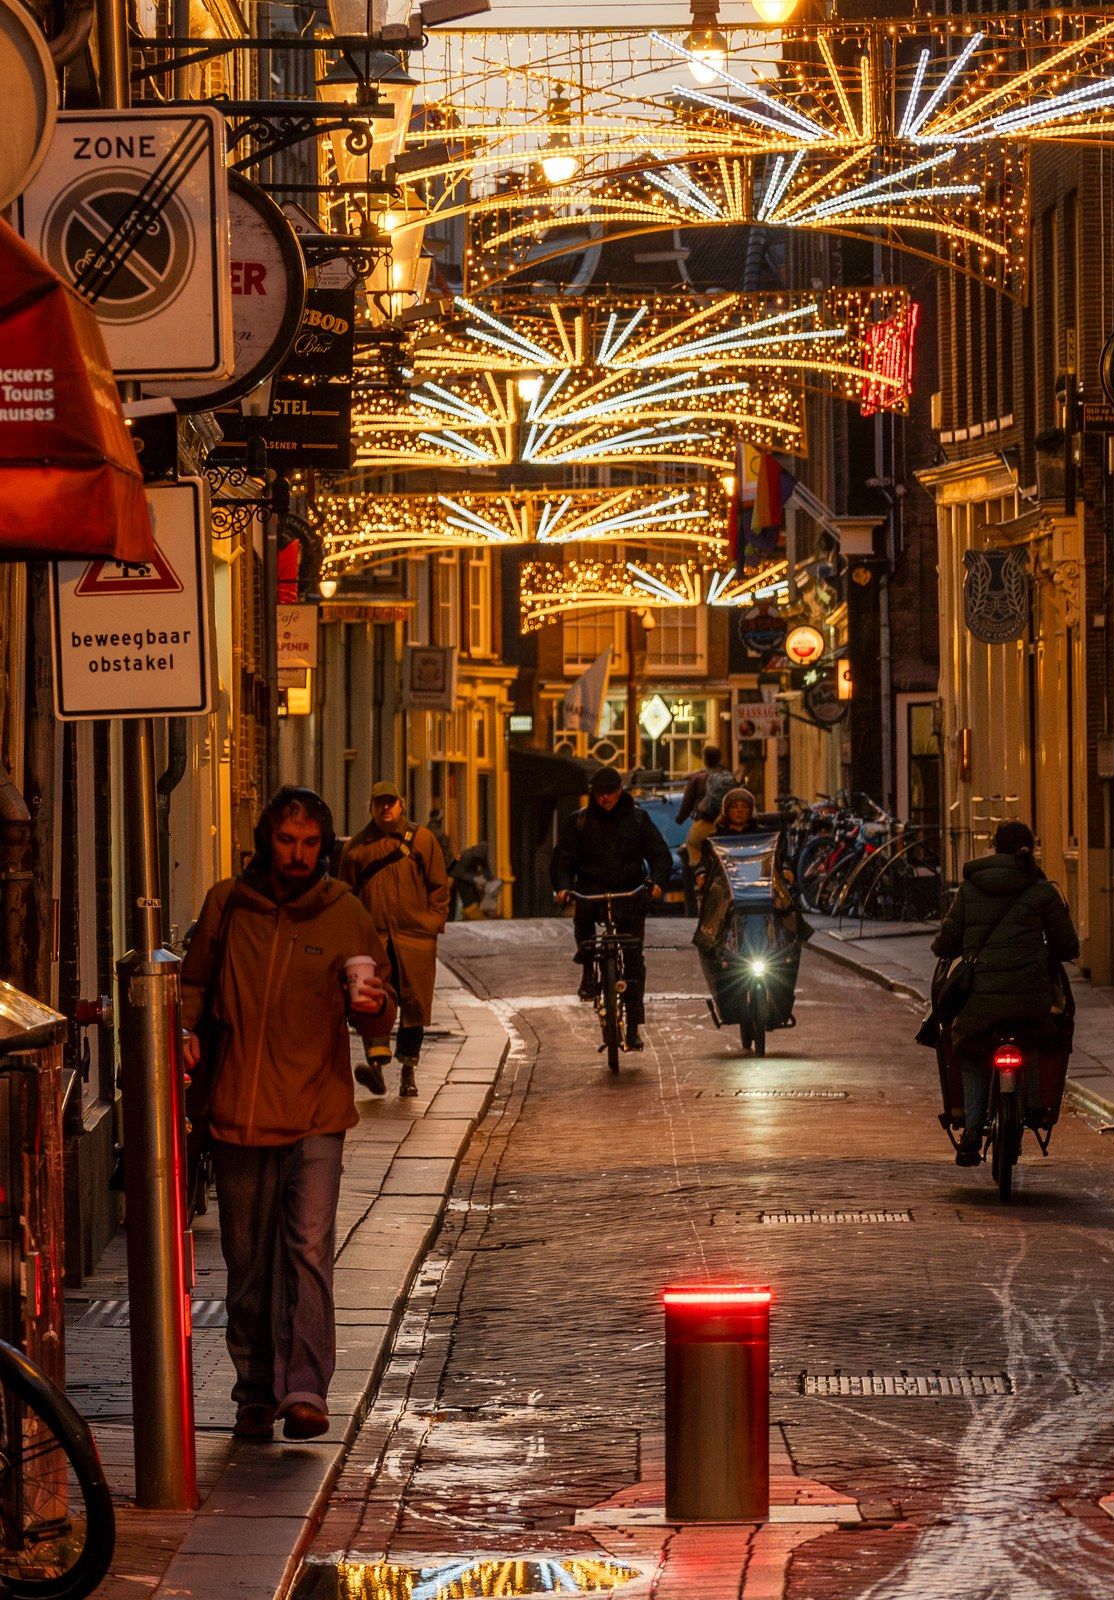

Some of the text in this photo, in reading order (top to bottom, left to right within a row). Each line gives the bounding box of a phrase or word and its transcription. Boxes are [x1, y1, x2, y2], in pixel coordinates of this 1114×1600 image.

[73, 135, 156, 159] ZONE
[71, 629, 191, 651] beweegbaar
[88, 652, 175, 673] obstakel
